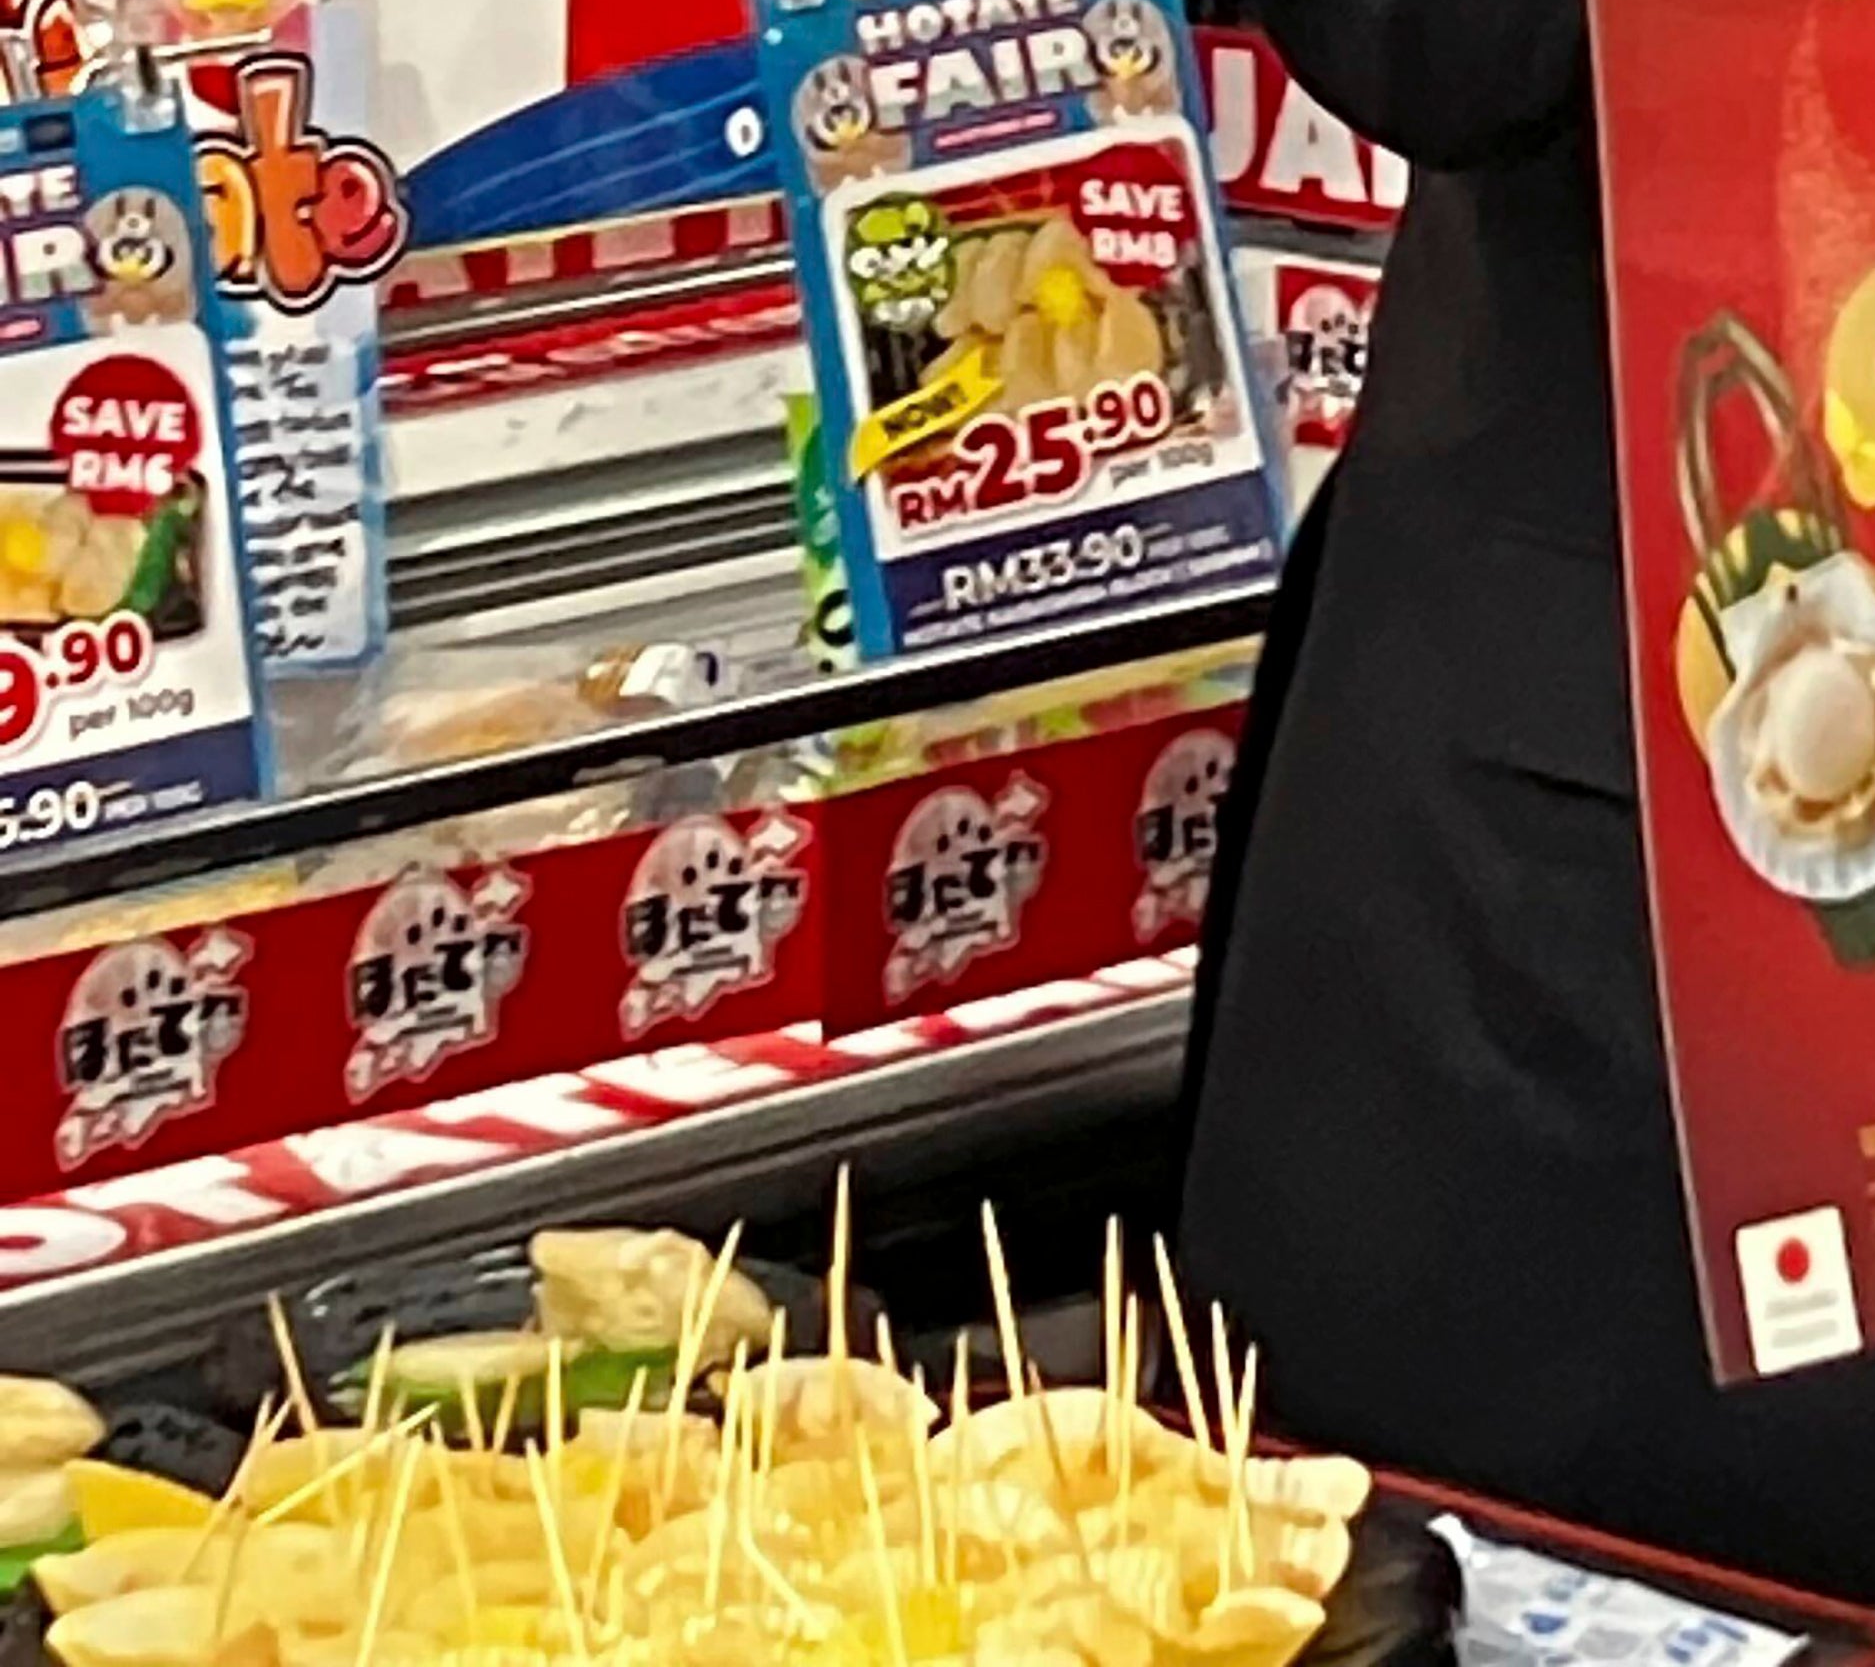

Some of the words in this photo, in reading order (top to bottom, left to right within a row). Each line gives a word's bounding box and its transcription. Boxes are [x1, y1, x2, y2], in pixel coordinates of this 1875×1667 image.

[870, 28, 1100, 129] FAIR
[1080, 178, 1185, 222] SAVE
[63, 401, 187, 443] SAVE
[71, 452, 174, 497] RM6
[70, 706, 116, 742] per
[127, 688, 194, 720] 100g
